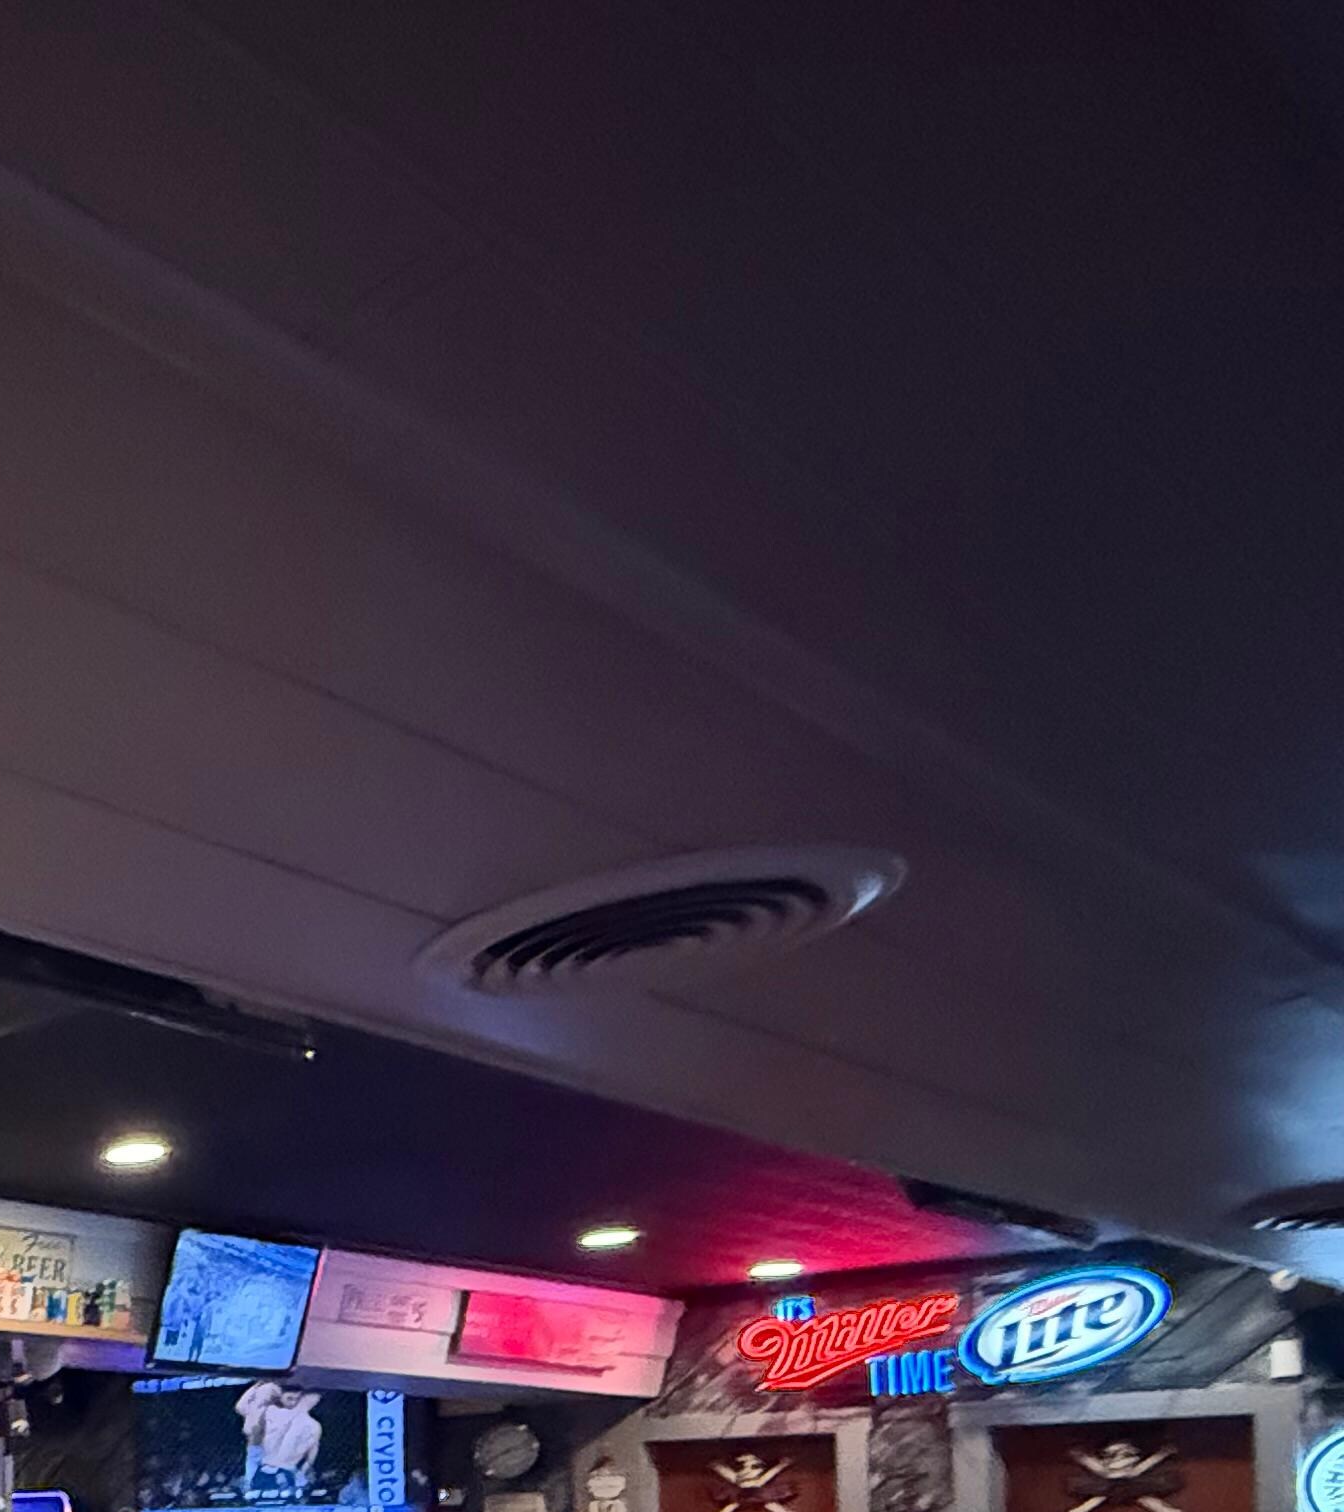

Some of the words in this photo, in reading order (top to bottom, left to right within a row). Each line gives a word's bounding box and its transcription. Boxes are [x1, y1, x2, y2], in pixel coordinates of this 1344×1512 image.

[13, 1253, 66, 1282] BEER
[774, 1297, 815, 1321] IT'S
[995, 1292, 1130, 1368] Lite
[737, 1294, 960, 1392] Miller
[865, 1349, 958, 1398] TIME
[373, 1415, 398, 1503] crypto
